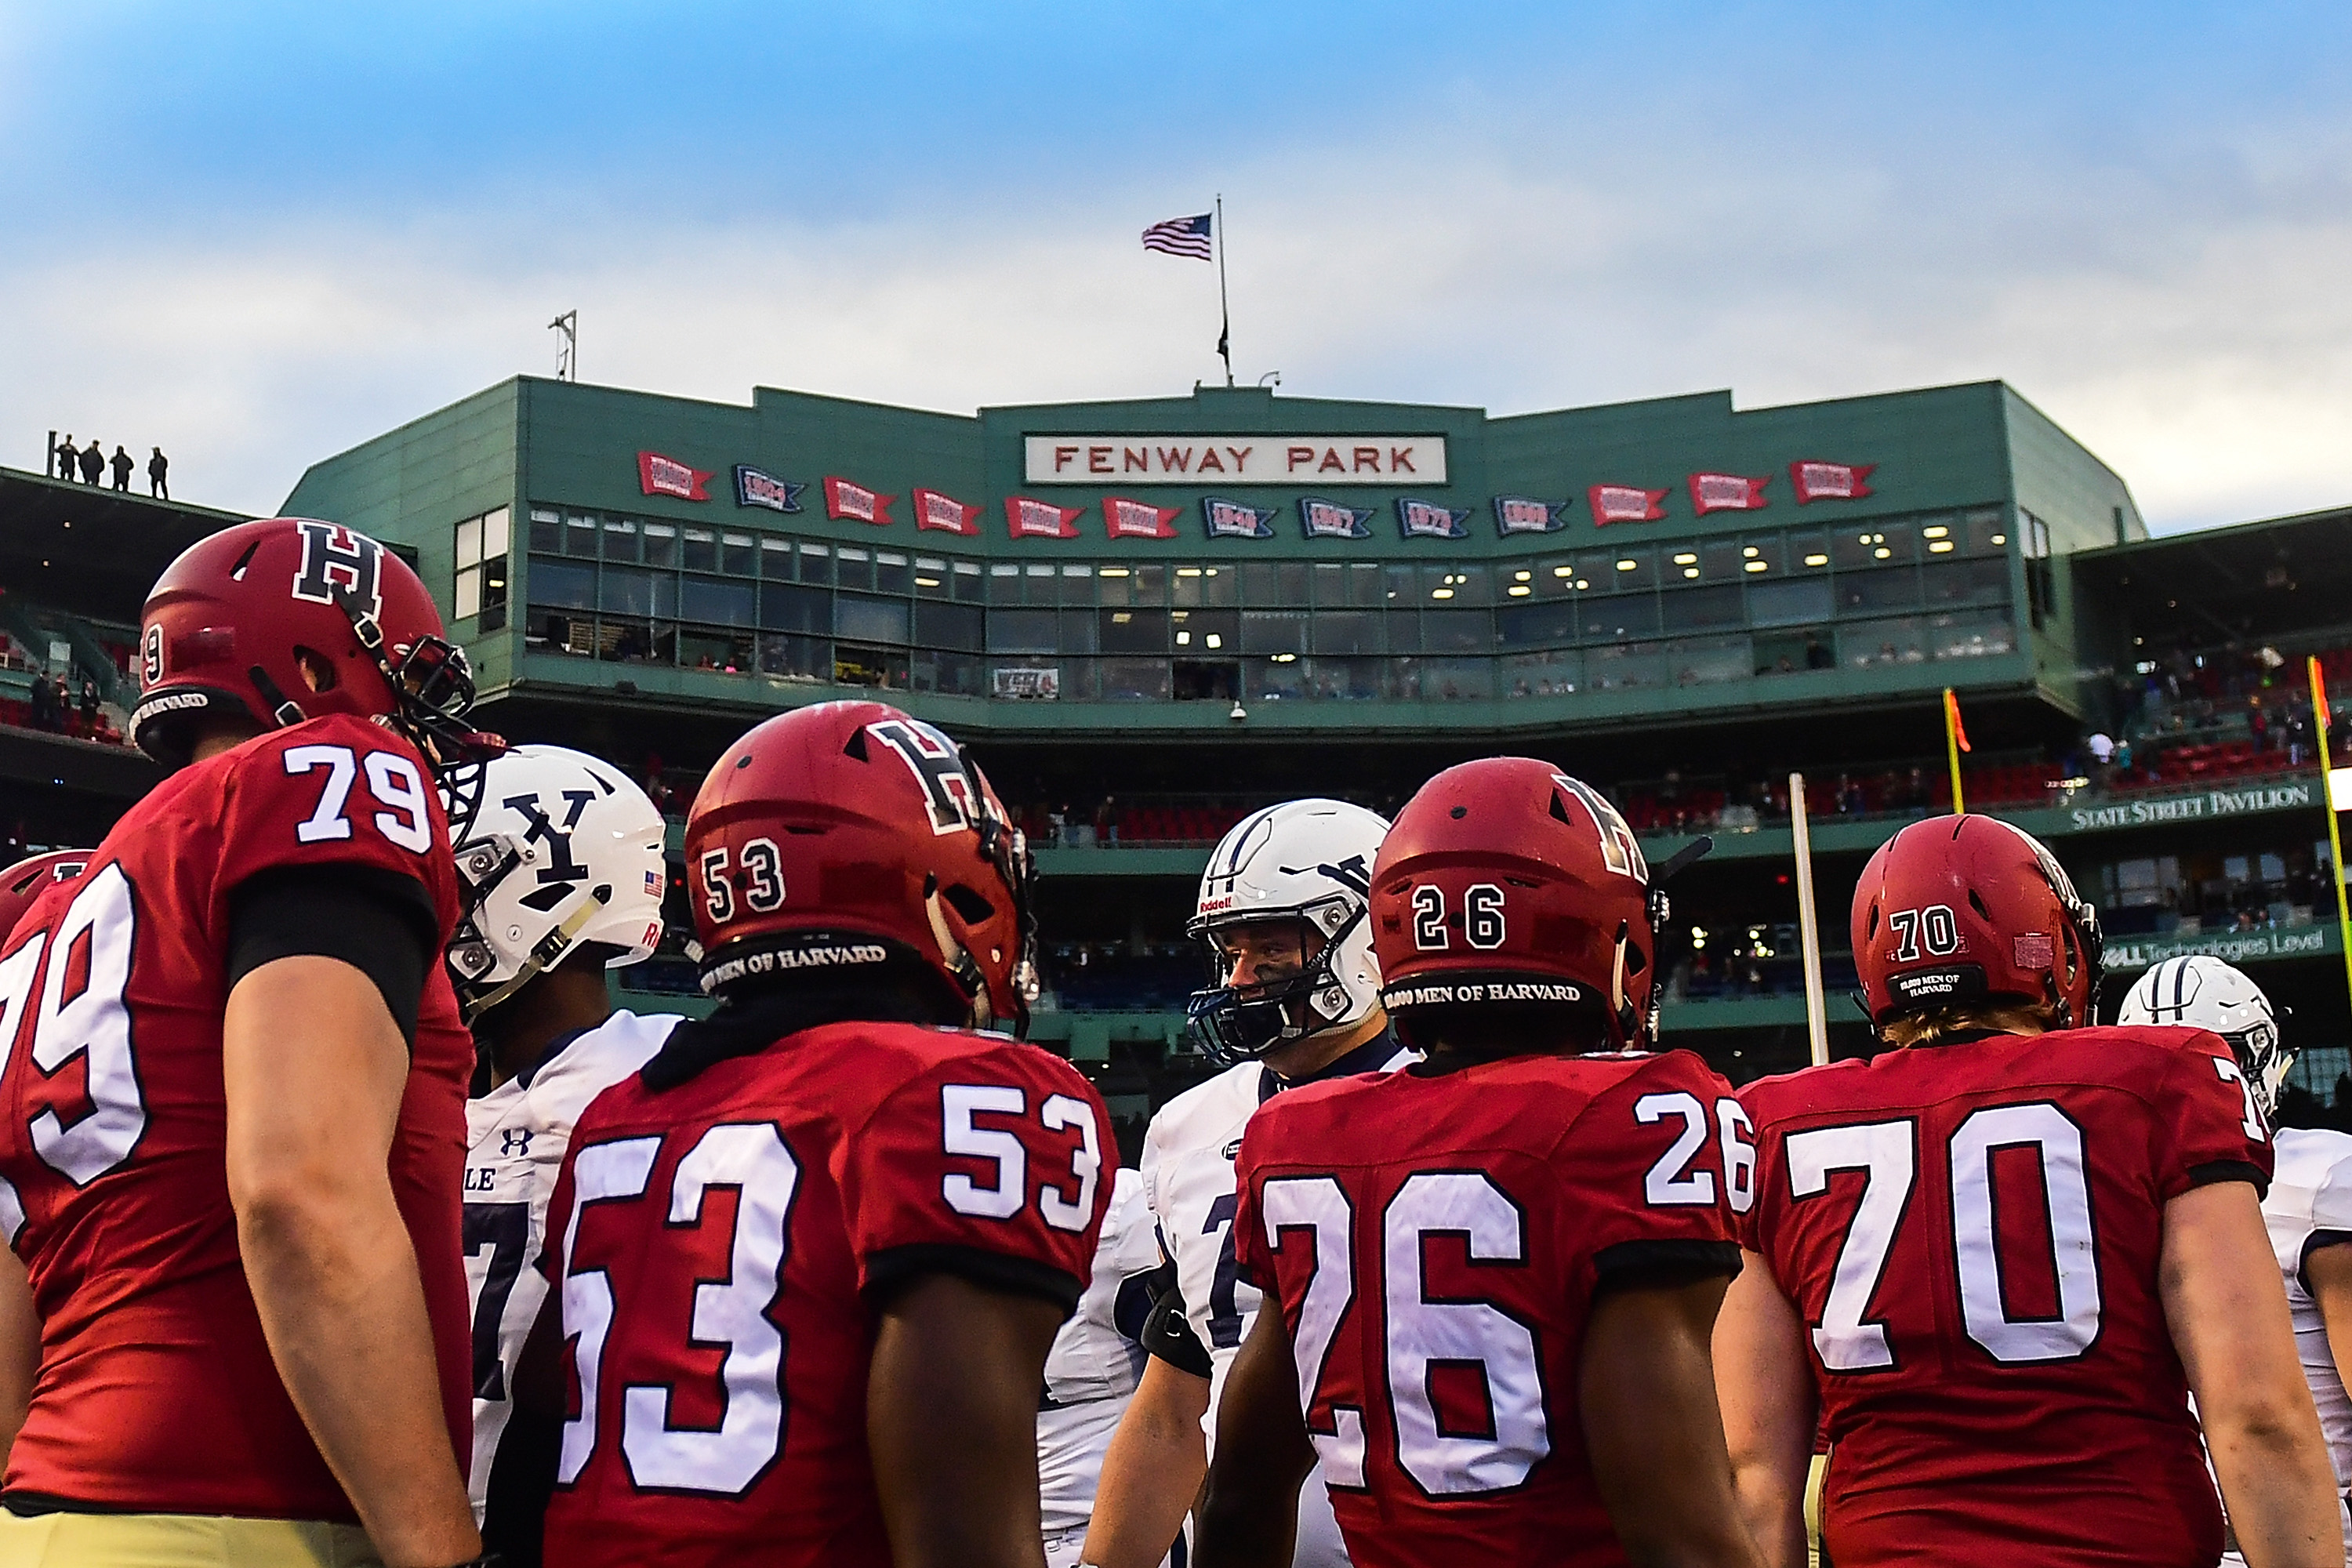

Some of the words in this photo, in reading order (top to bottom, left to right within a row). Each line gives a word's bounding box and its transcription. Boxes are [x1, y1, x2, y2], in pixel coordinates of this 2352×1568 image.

[1055, 446, 1253, 473] FENWAY
[1288, 446, 1417, 473] PARK
[292, 521, 386, 624] H
[140, 623, 165, 686] 9
[284, 746, 433, 855] 79
[866, 719, 982, 837] H
[503, 789, 597, 884] Y
[701, 837, 786, 924] 53
[1200, 897, 1232, 913] Riddell
[1412, 884, 1506, 951] 26
[777, 946, 887, 969] HARVARD
[1889, 905, 1958, 962] 70
[2274, 930, 2324, 952] Level
[1416, 987, 1453, 1004] MEN
[1457, 986, 1484, 1002] OF
[1488, 984, 1581, 1001] HARVARD
[1909, 984, 1953, 998] HARVARD
[1922, 975, 1944, 985] MEN
[1945, 975, 1960, 984] OF
[2212, 1057, 2271, 1143] 7
[943, 1084, 1099, 1232] 53
[1634, 1092, 1756, 1214] 26
[1787, 1103, 2100, 1370] 70
[557, 1121, 798, 1494] 53
[1263, 1173, 1551, 1494] 26
